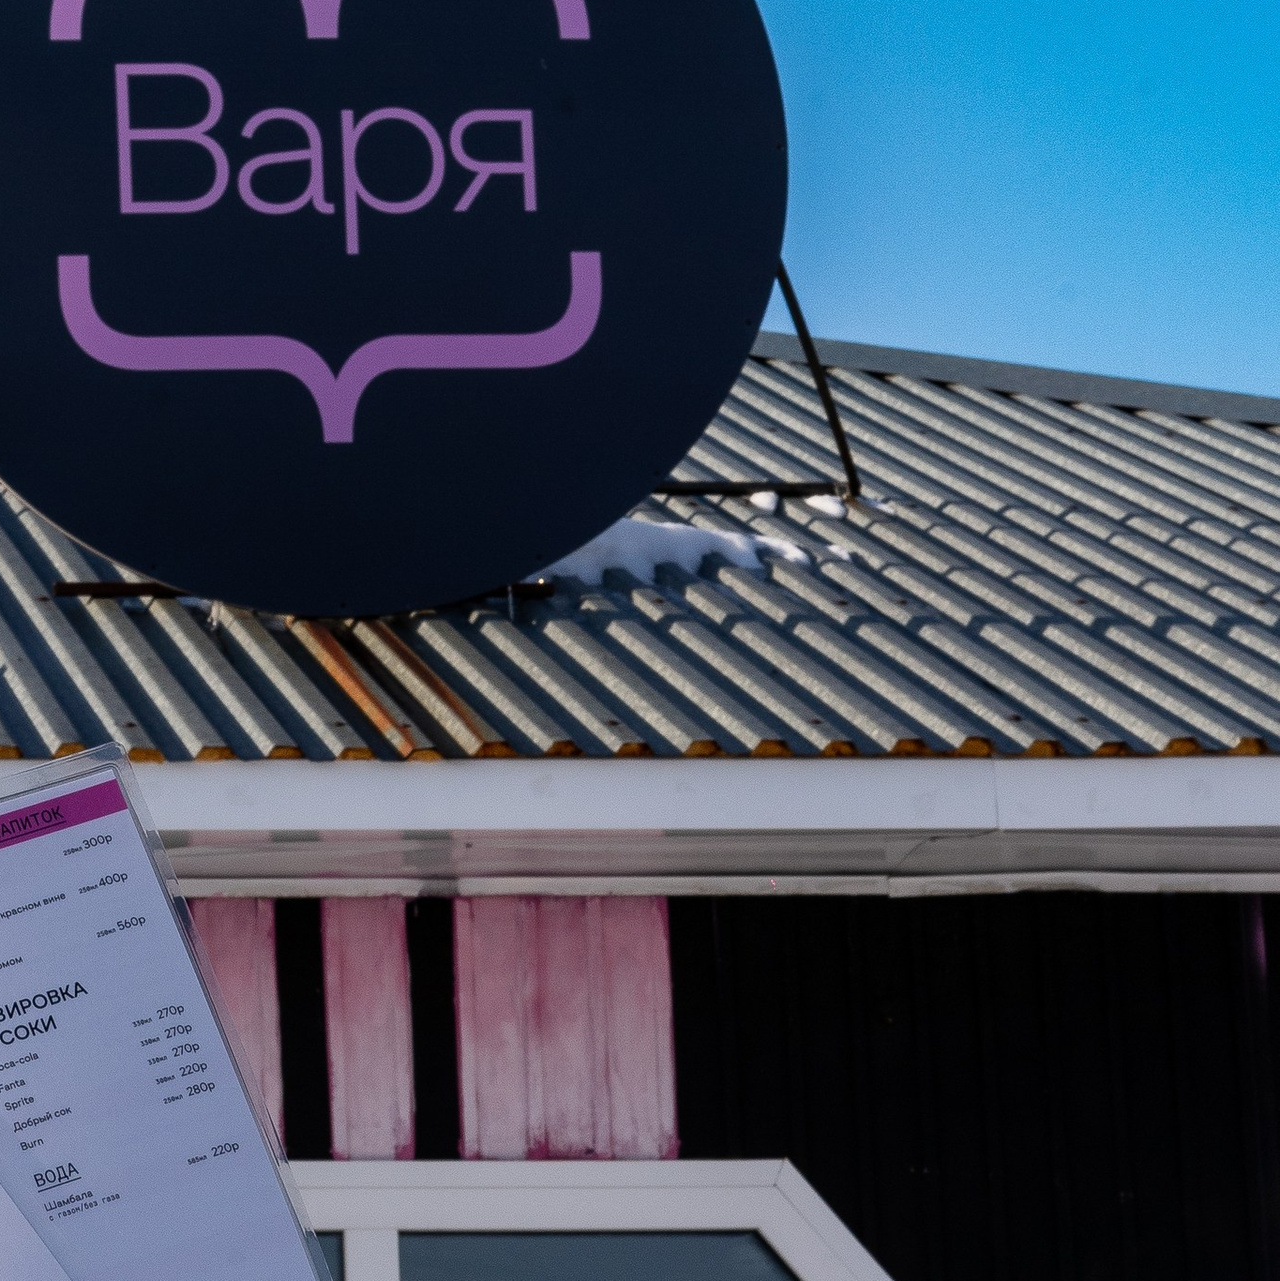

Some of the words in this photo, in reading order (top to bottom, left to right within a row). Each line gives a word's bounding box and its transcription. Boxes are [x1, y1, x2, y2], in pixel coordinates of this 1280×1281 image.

[113, 61, 538, 255] Варя
[81, 834, 113, 849] 300р
[98, 872, 128, 887] 400р
[0, 900, 42, 919] красном
[41, 892, 66, 905] вине
[115, 915, 146, 931] 560р
[155, 1004, 185, 1020] 270р
[163, 1023, 192, 1039] 270р
[170, 1042, 200, 1057] 270р
[178, 1061, 208, 1077] 220р
[185, 1081, 216, 1097] 280р
[3, 1095, 34, 1111] Sprite
[12, 1110, 53, 1133] Добрый
[53, 1106, 72, 1118] сок
[19, 1137, 44, 1151] Burn
[210, 1141, 239, 1157] 220р
[33, 1161, 80, 1189] ВОДА
[43, 1190, 94, 1212] Шамбала
